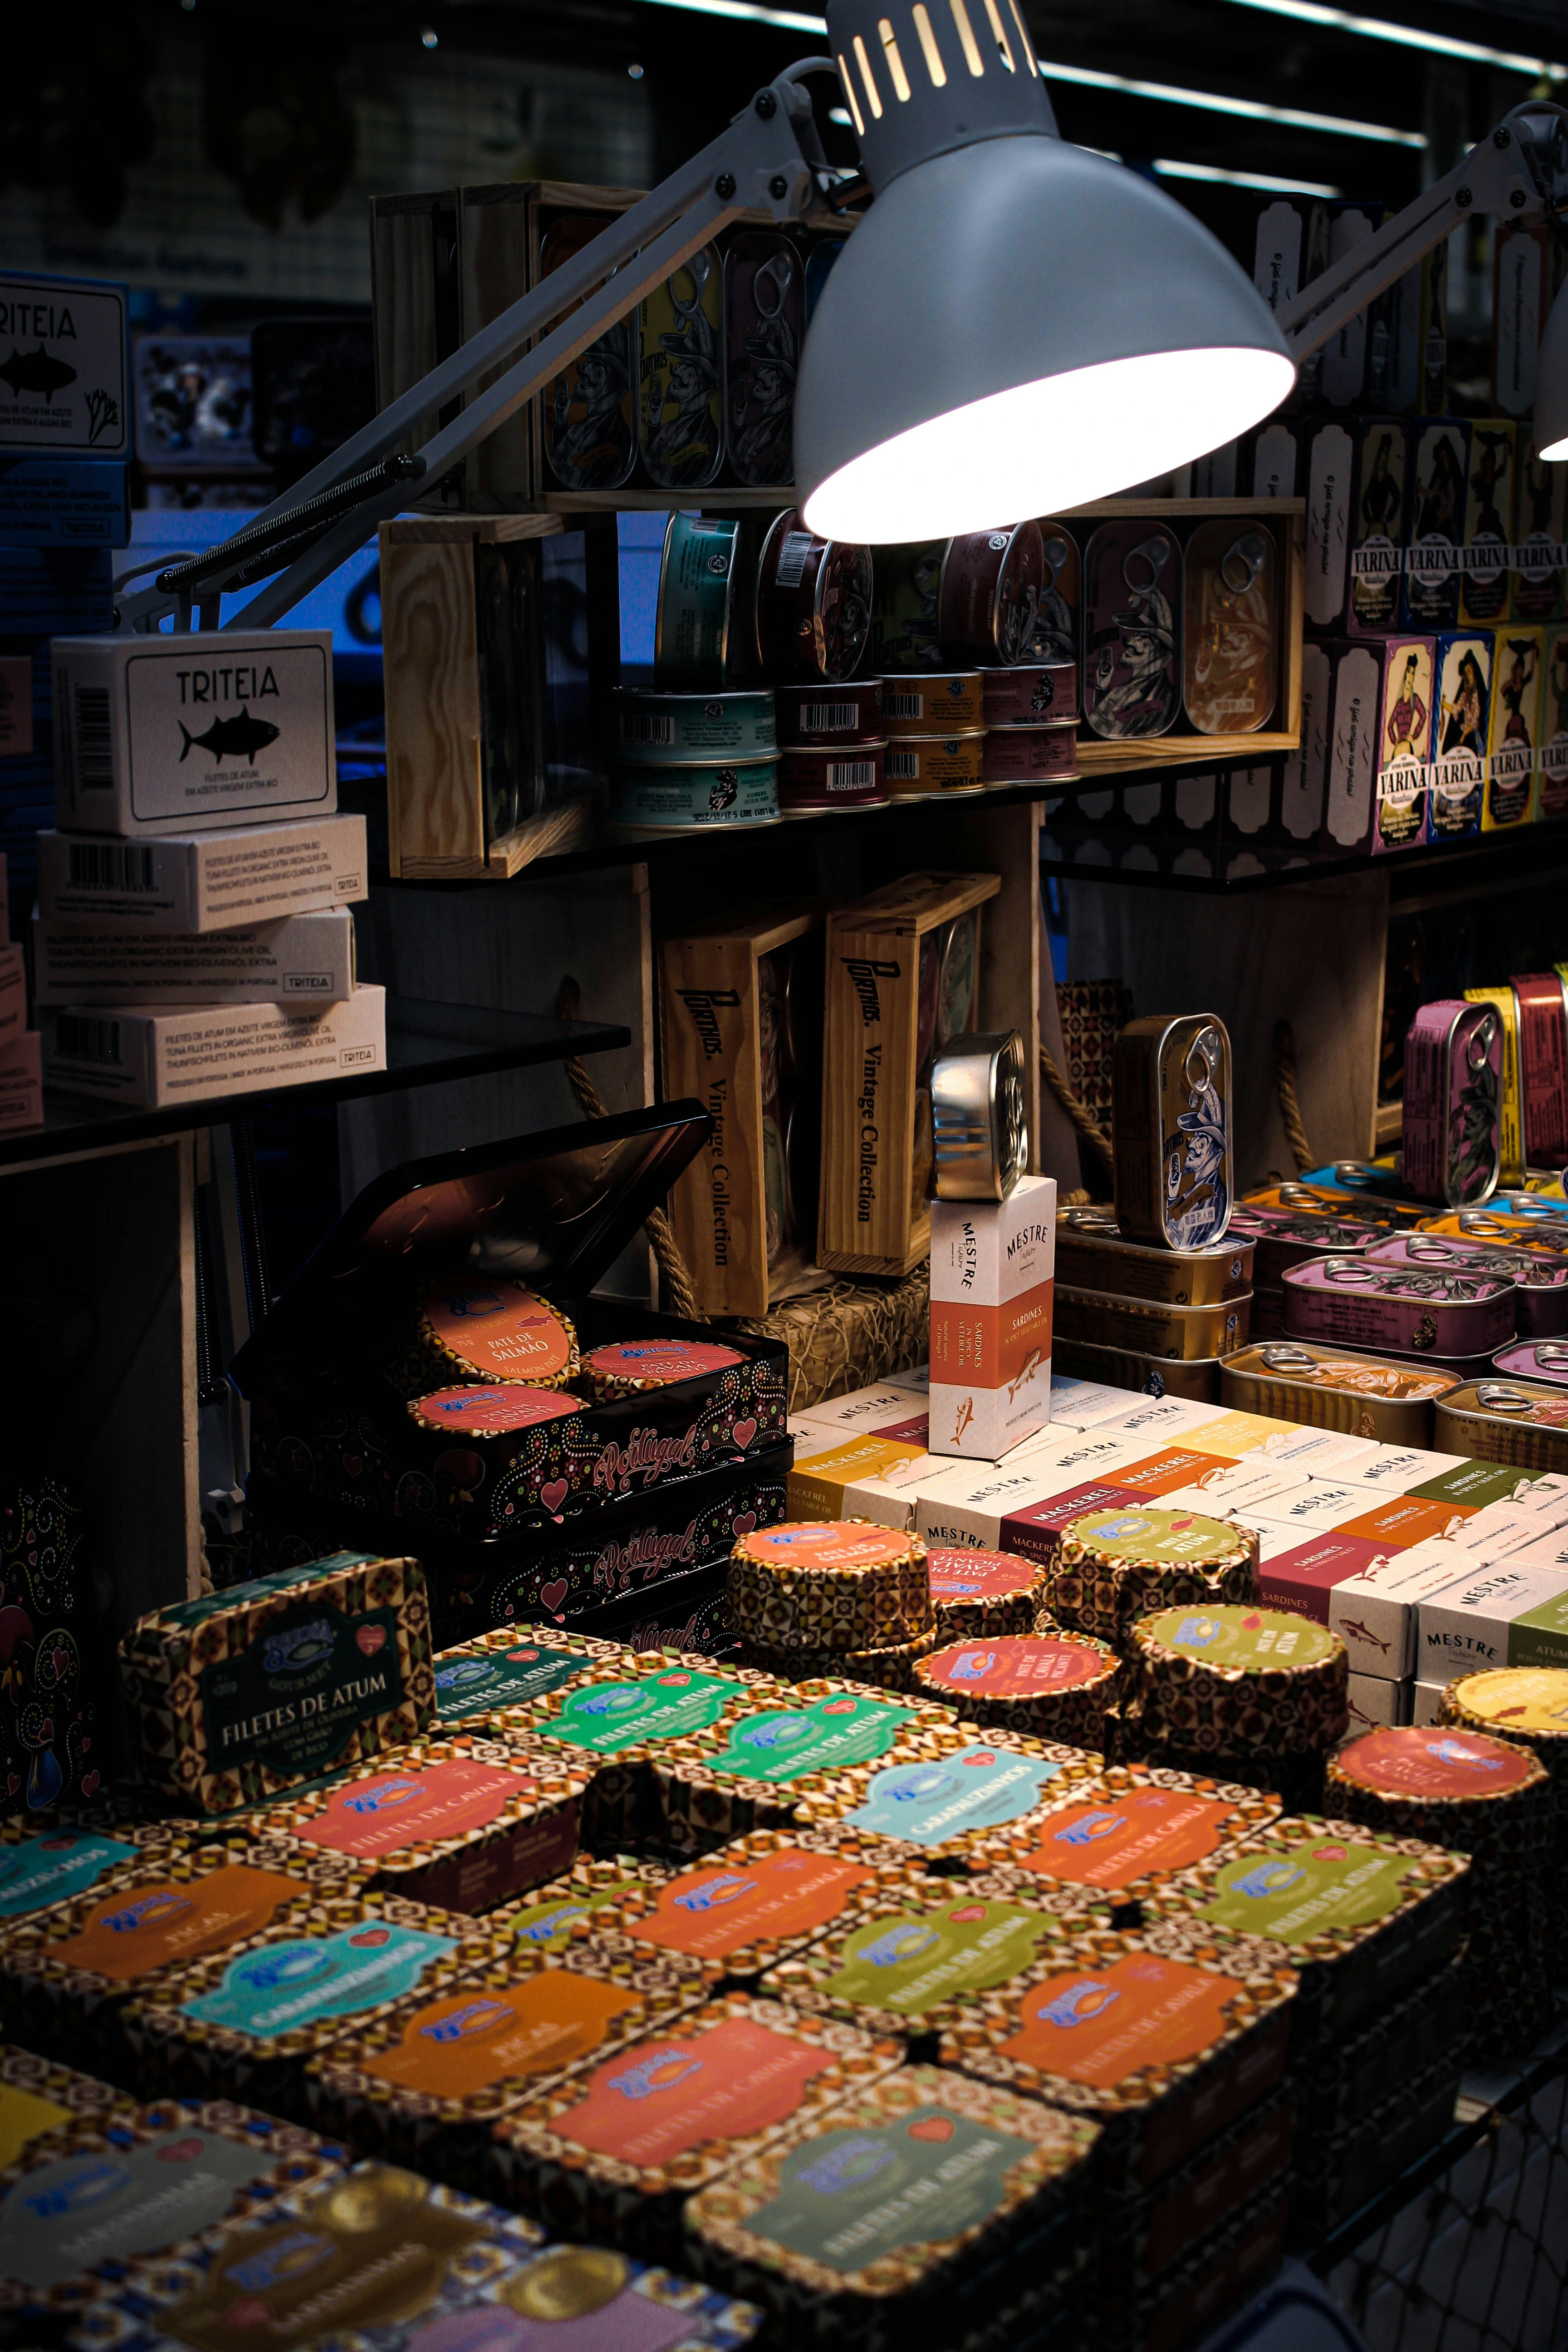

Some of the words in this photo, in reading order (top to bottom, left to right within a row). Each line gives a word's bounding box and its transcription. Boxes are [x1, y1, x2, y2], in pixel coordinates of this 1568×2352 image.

[0, 303, 77, 339] RITEIA
[1322, 502, 1332, 530] amigo
[1356, 550, 1399, 573] VARINA
[1409, 549, 1458, 569] VARINA
[1463, 547, 1509, 568] VARINA
[1516, 546, 1563, 568] VARINA
[176, 666, 280, 704] TRITEIA
[1350, 707, 1359, 722] fiel
[1348, 725, 1357, 752] amigo
[1435, 761, 1483, 785] VARINA
[1490, 751, 1532, 776] VARINA
[1381, 767, 1426, 795] VARINA
[174, 934, 208, 942] VIRGEM
[229, 945, 255, 954] OLIVE
[249, 957, 277, 967] EXTRA
[288, 978, 328, 989] TRITEIA
[344, 1049, 372, 1062] TRITEIA
[858, 1044, 882, 1121] Vintage
[858, 1127, 879, 1223] Collection
[710, 1165, 731, 1266] Collection
[1007, 1225, 1049, 1260] MESTRE
[961, 1222, 976, 1290] MESTRE
[1012, 1305, 1042, 1330] SARDINES
[487, 1335, 514, 1349] PATÉ
[516, 1332, 535, 1341] DE
[492, 1339, 549, 1361] SALMÃO
[974, 1322, 983, 1368] SARDINES
[504, 1365, 546, 1375] SALMON
[489, 1405, 547, 1422] CAVALA
[501, 1407, 557, 1424] PICANTE
[837, 1395, 906, 1420] MESTRE
[1123, 1405, 1187, 1429] MESTRE
[594, 1425, 697, 1494] Portugal
[804, 1443, 888, 1472] MACKEREL
[1056, 1442, 1124, 1468] MESTRE
[1363, 1454, 1425, 1480] MESTRE
[896, 1479, 918, 1490] PRODUCT
[931, 1465, 956, 1476] PORTUGAL
[1121, 1453, 1199, 1485] MACKEREL
[1443, 1470, 1487, 1490] SARDINES
[967, 1476, 1038, 1502] MESTRE
[1216, 1487, 1239, 1498] PRODUCT
[1250, 1474, 1272, 1485] PORTUGAL
[1031, 1487, 1116, 1522] MACKEREL
[1056, 1507, 1076, 1522] SPICY
[1076, 1498, 1105, 1515] TOMATO
[1104, 1490, 1126, 1504] SAUCE
[1289, 1490, 1354, 1516] MESTRE
[1374, 1506, 1420, 1527] SARDINES
[927, 1526, 987, 1549] MESTRE
[1012, 1535, 1055, 1554] MACKERE
[1172, 1534, 1214, 1553] ATUM
[593, 1520, 696, 1588] Portugal
[933, 1560, 997, 1572] CAVALA
[1294, 1545, 1343, 1568] SARDINES
[1261, 1592, 1308, 1610] SARDINES
[1460, 1573, 1528, 1606] MESTRE
[1427, 1633, 1498, 1660] MESTRE
[437, 1691, 498, 1717] FILETES
[500, 1682, 523, 1700] DE
[525, 1658, 572, 1684] ATUM
[222, 1708, 296, 1747] FILETES
[300, 1698, 327, 1720] DE
[332, 1672, 387, 1709] ATUM
[591, 1717, 653, 1746] FILETES
[654, 1706, 676, 1724] DE
[677, 1683, 725, 1709] ATUM
[827, 1730, 849, 1749] DE
[847, 1709, 893, 1737] ATUM
[349, 1814, 422, 1851] FILETES
[422, 1803, 444, 1822] DE
[446, 1775, 515, 1809] CAVALA
